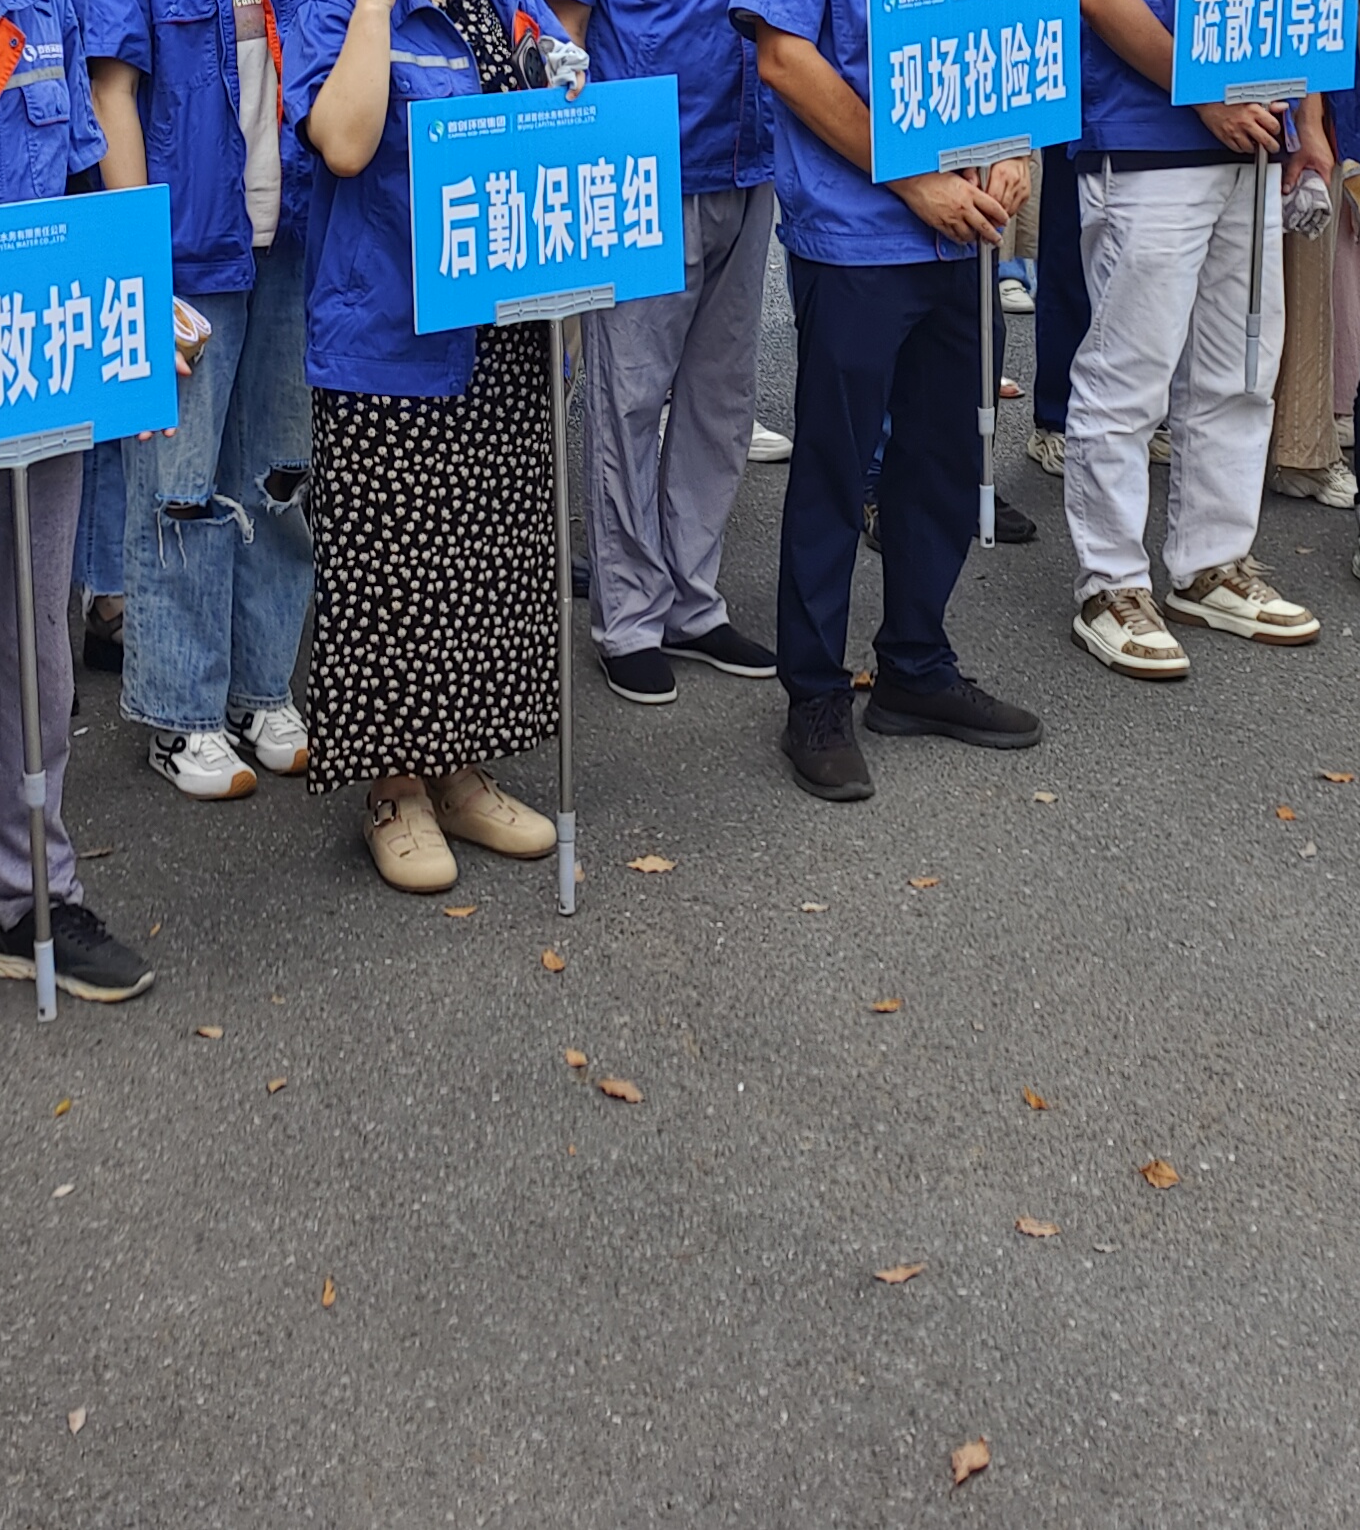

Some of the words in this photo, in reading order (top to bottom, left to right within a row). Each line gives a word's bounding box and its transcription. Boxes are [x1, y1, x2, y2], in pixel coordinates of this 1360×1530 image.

[890, 19, 1066, 133] 现场抢险组
[439, 155, 663, 278] 后勤保障组
